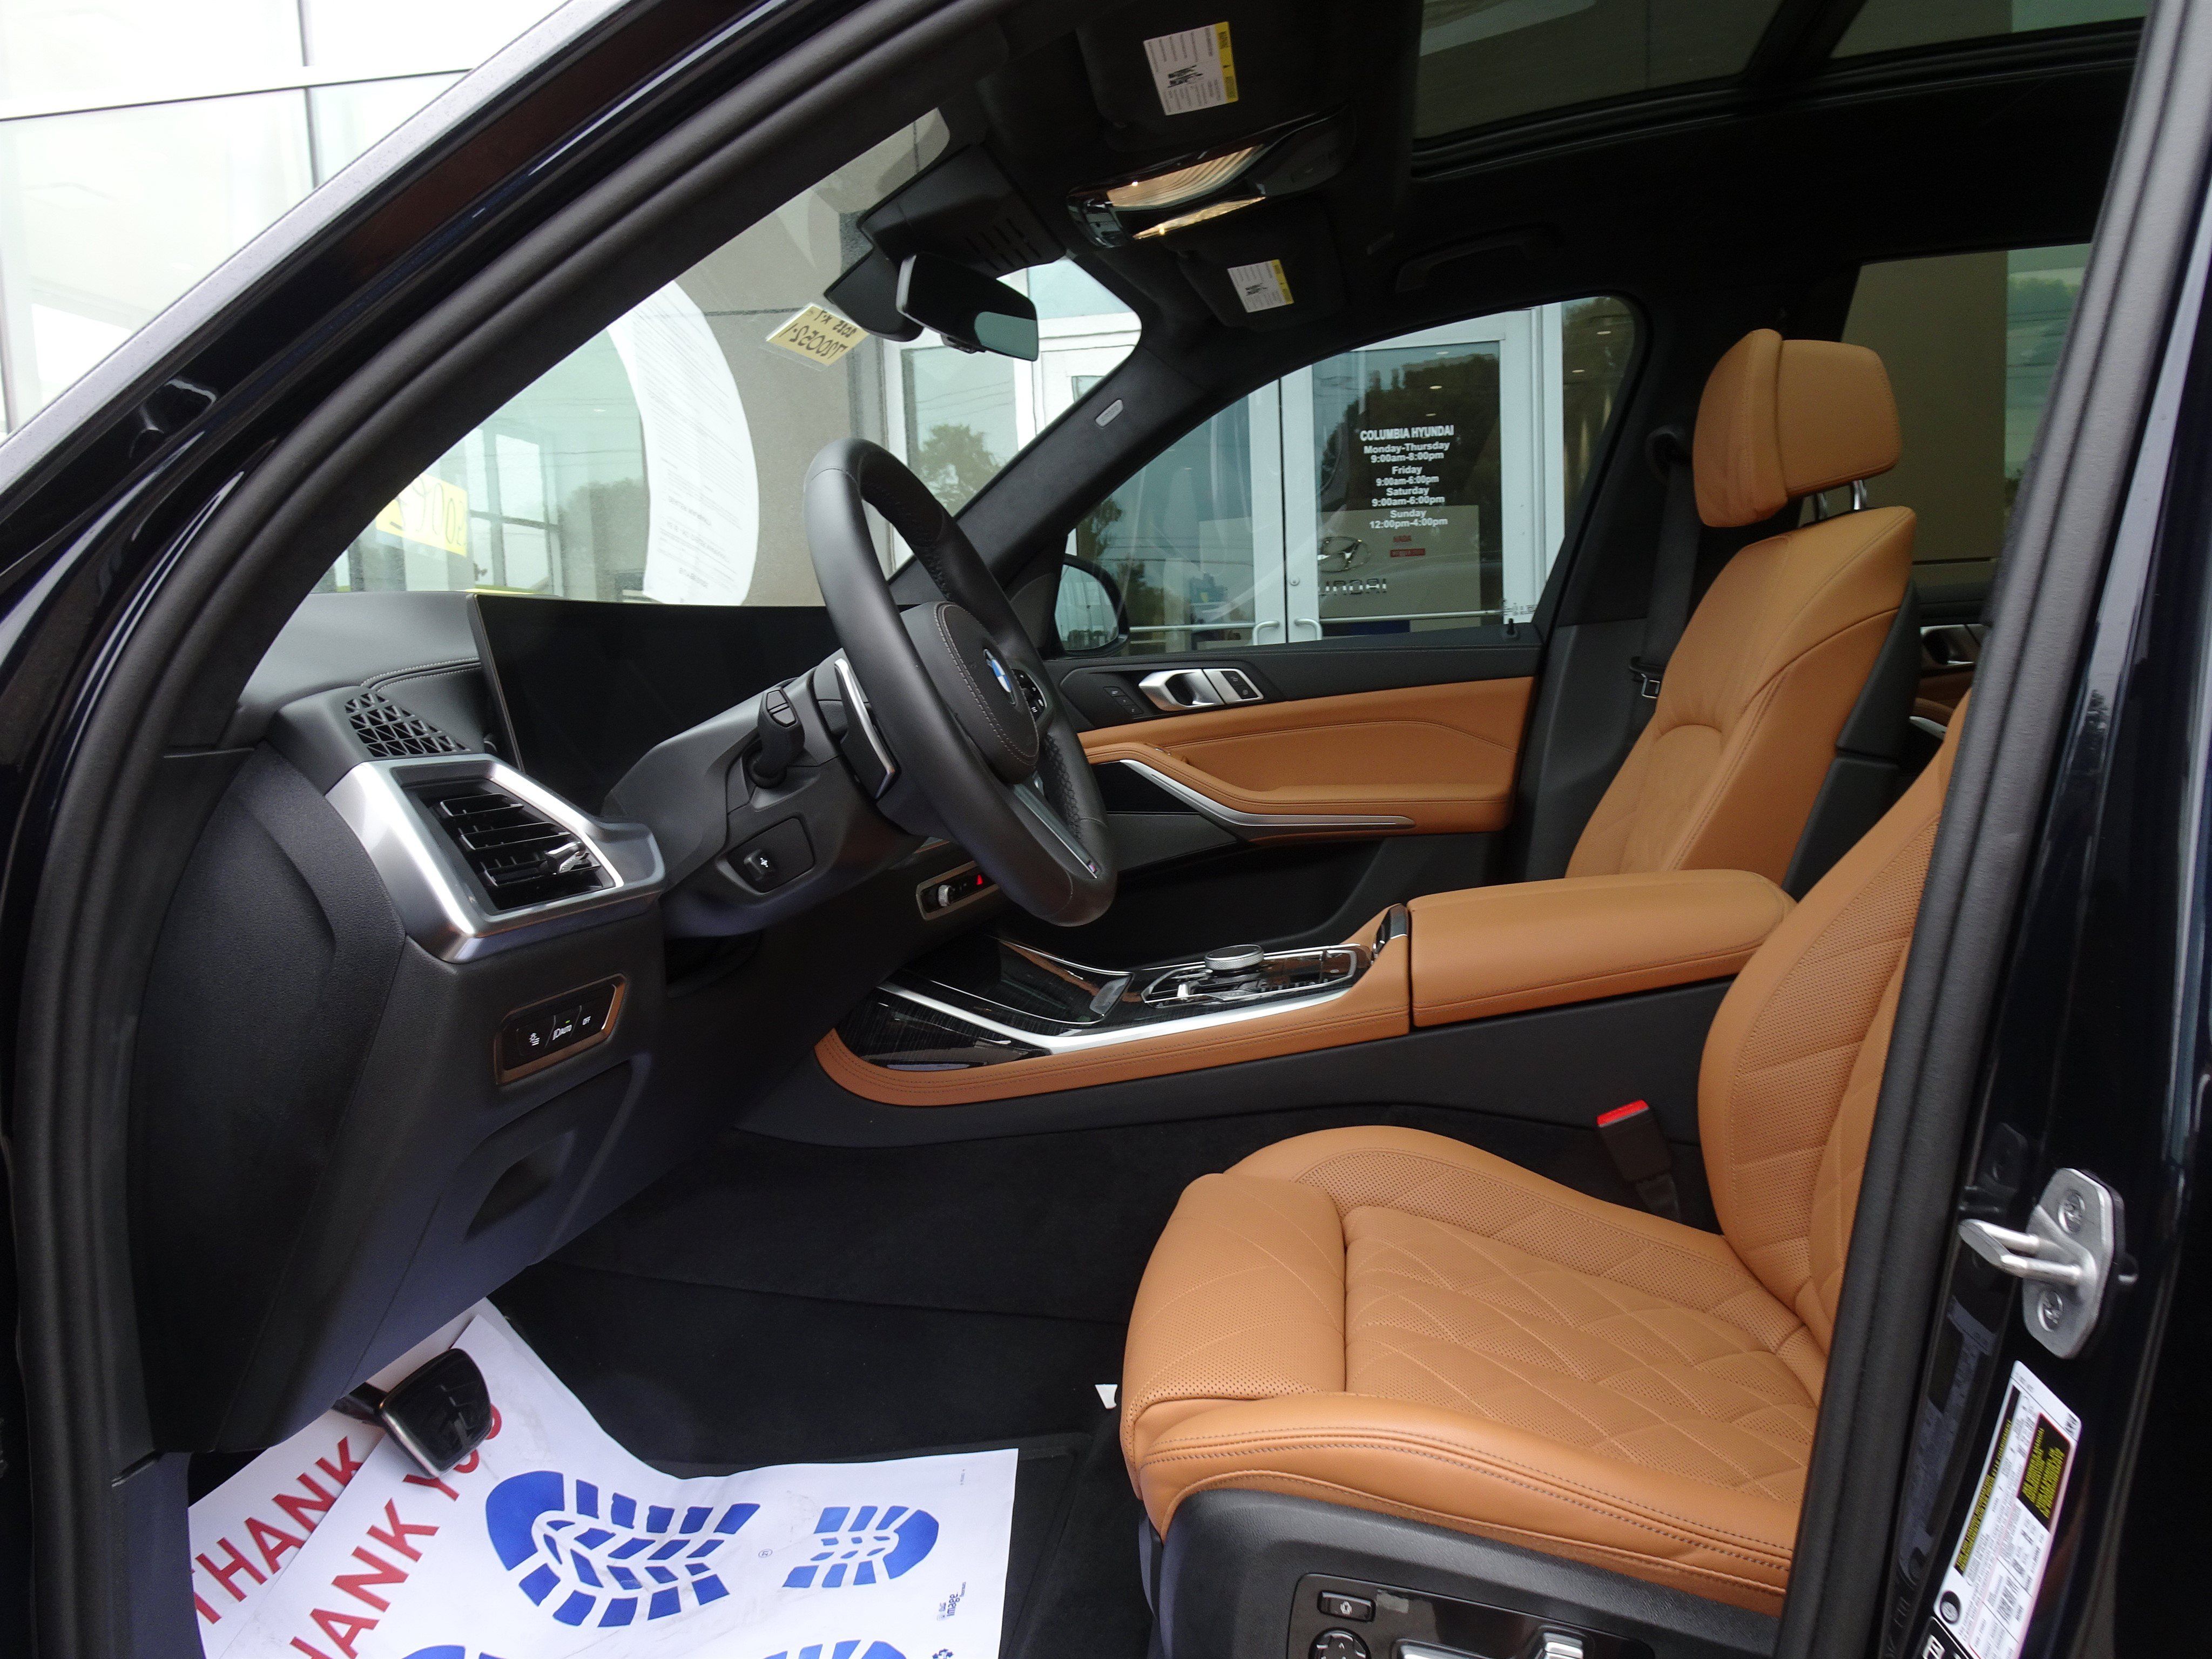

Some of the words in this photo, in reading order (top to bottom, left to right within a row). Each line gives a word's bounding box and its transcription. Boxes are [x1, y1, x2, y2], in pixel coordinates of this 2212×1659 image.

[1360, 428, 1410, 441] COLUMBIA
[1411, 425, 1454, 438] HYUNDAI
[1364, 441, 1451, 454] Monday-Thursday
[1392, 466, 1423, 475] Friday
[1386, 487, 1430, 496] Saturday
[1390, 509, 1427, 518] Sunday
[947, 1593, 960, 1616] image
